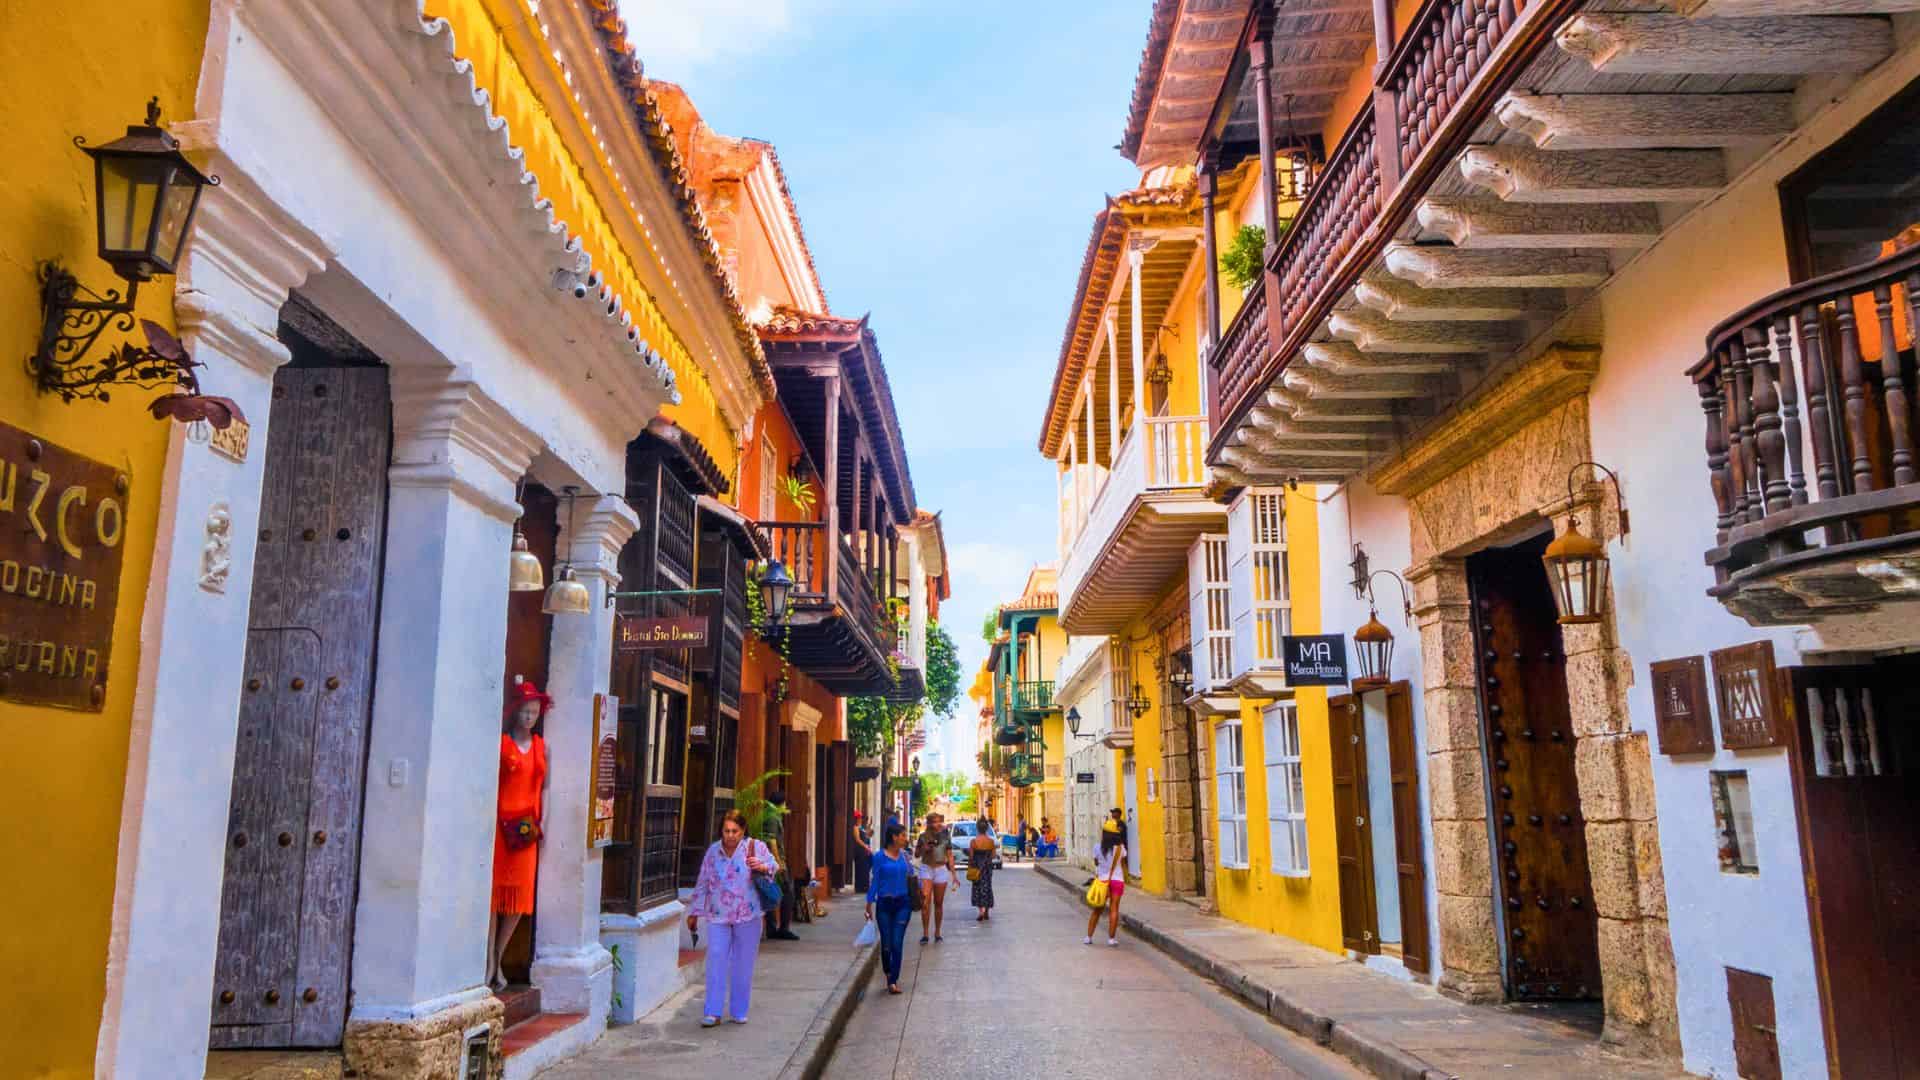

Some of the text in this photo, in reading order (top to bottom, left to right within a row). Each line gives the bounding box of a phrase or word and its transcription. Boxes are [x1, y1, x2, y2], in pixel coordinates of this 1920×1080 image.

[1, 559, 97, 610] OCINA
[1300, 642, 1330, 661] MA
[1290, 662, 1342, 674] Marco Antonio
